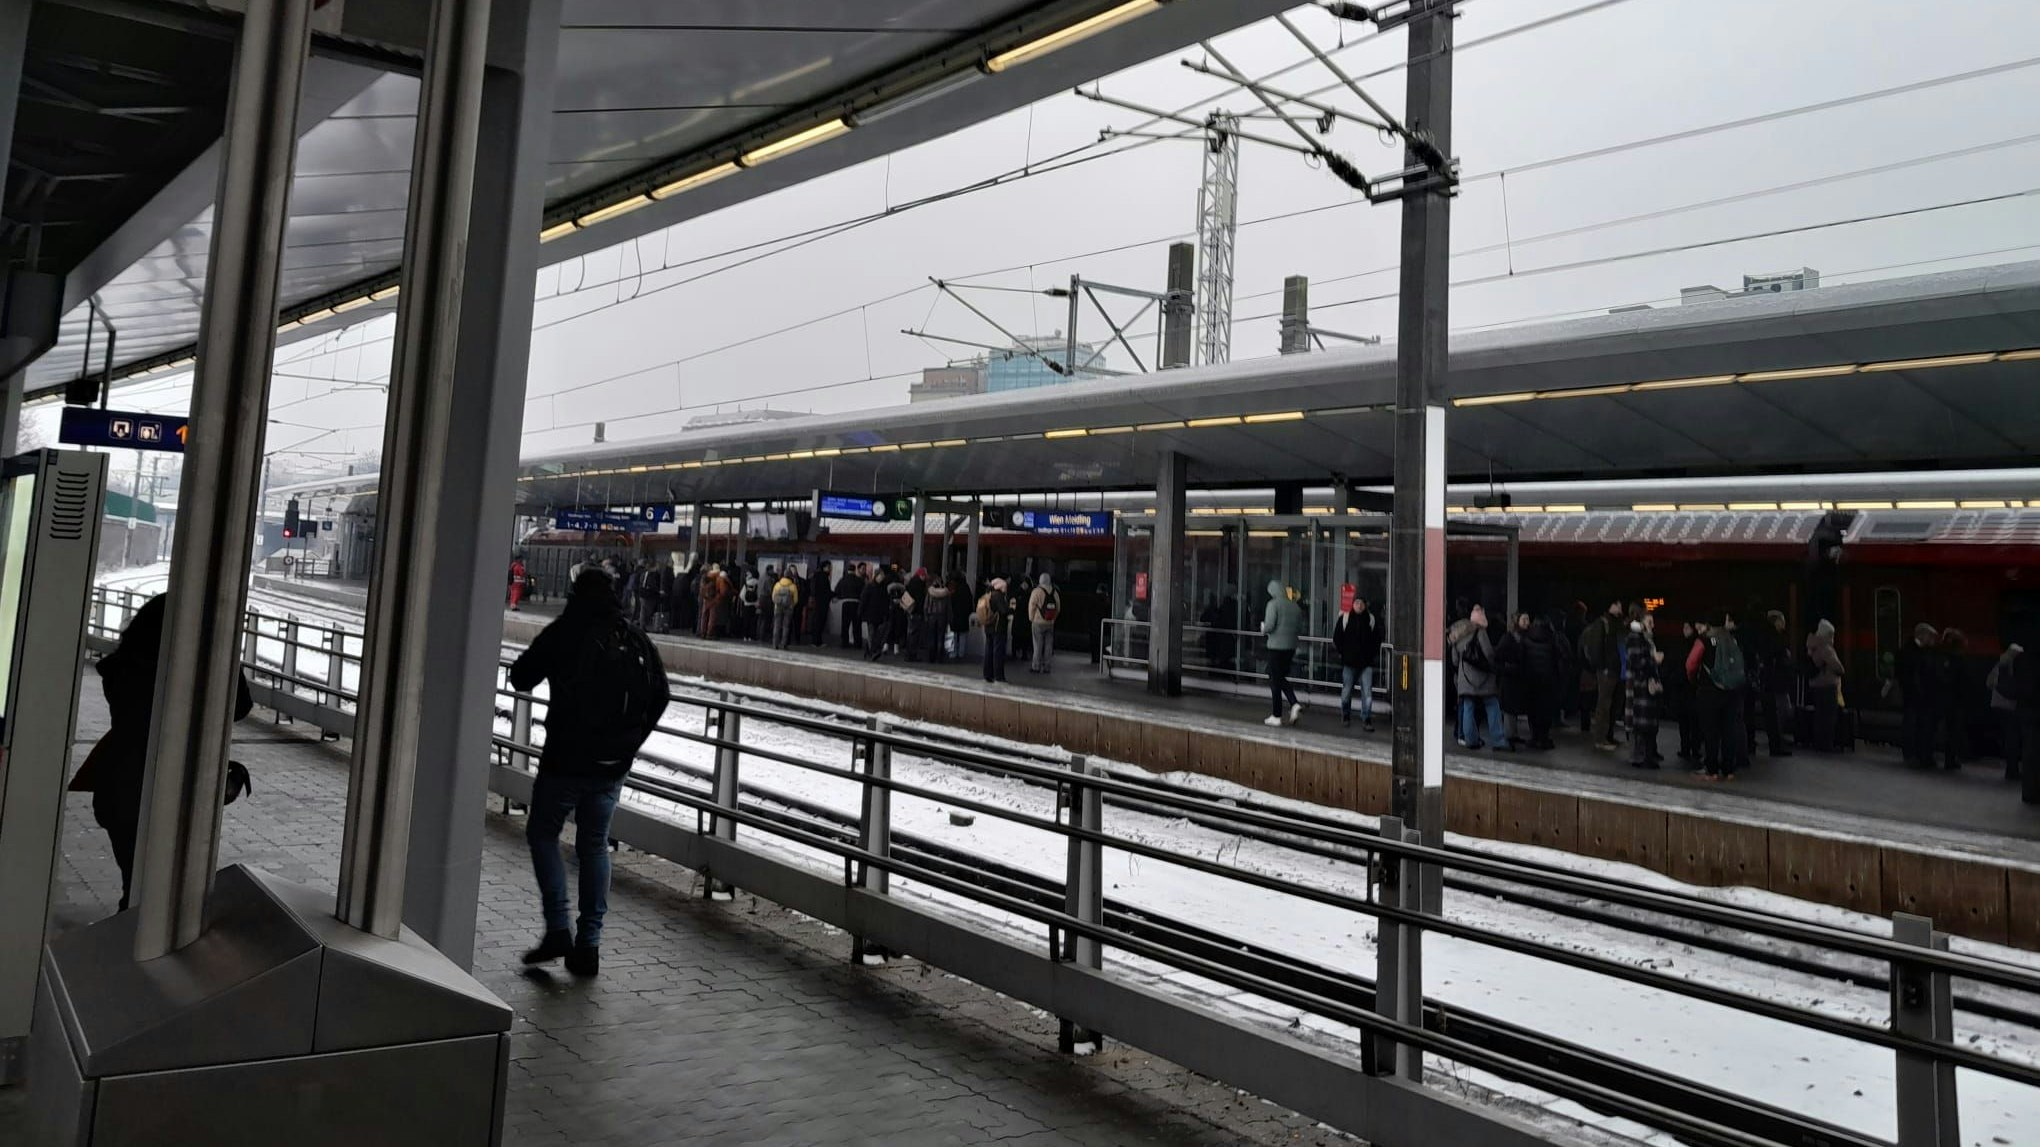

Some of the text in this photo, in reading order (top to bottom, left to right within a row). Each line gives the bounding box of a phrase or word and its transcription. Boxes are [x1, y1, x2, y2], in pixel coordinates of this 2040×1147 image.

[646, 507, 670, 521] 6 A
[1049, 514, 1091, 527] Wien Meidling
